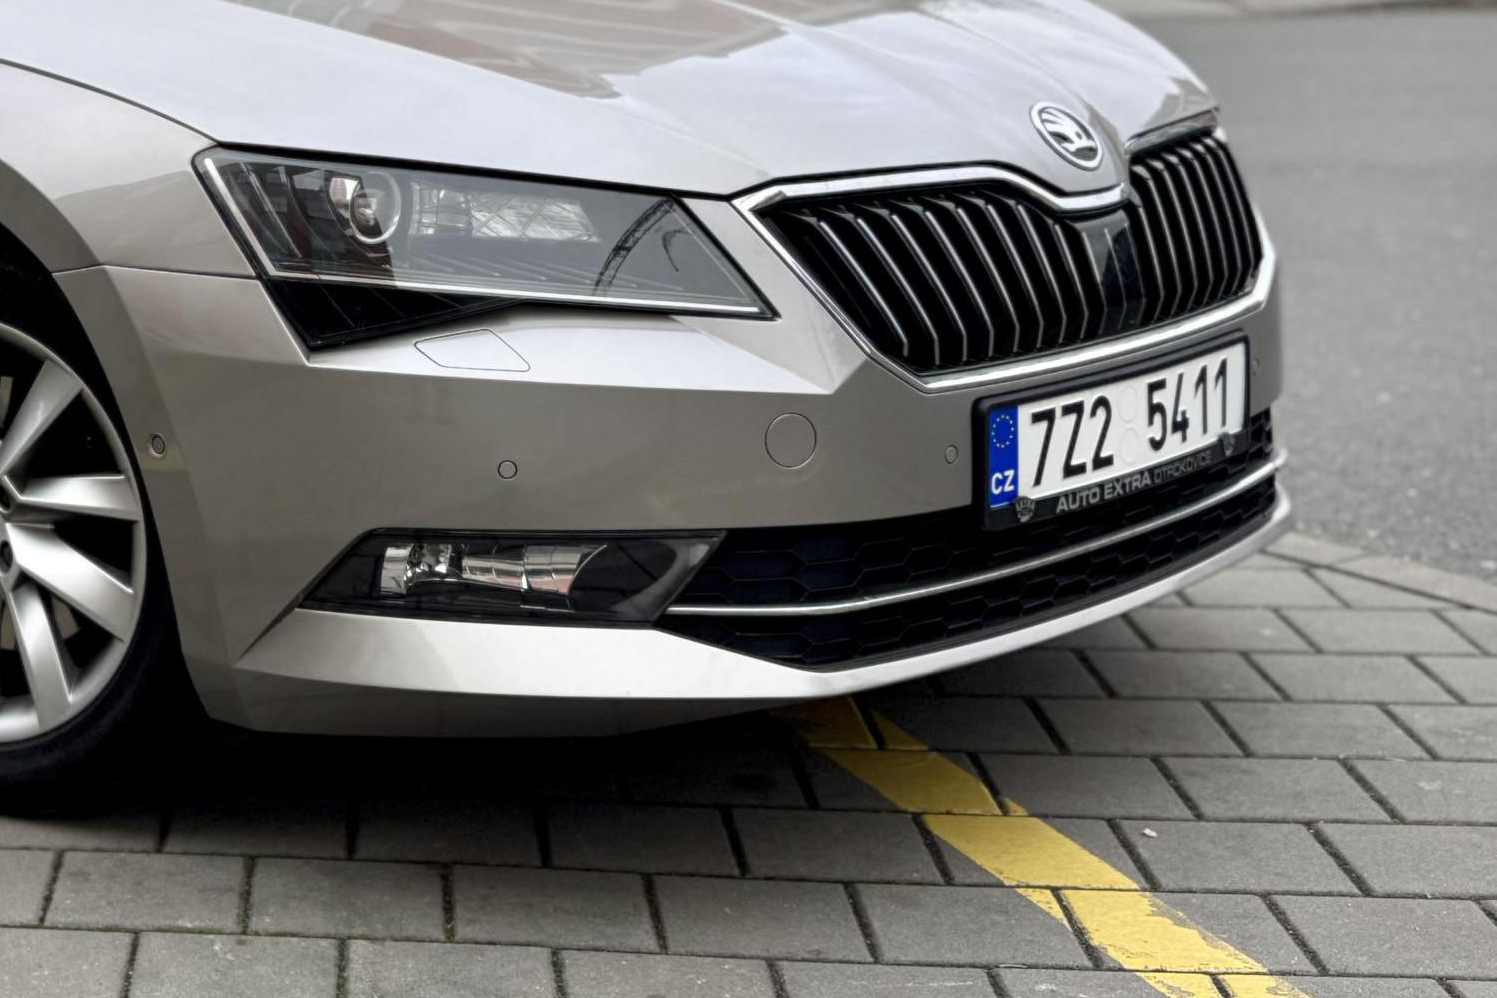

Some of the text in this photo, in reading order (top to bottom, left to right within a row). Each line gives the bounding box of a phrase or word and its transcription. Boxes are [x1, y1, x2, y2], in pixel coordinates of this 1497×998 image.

[1031, 357, 1228, 487] 7Z2 5411
[991, 469, 1015, 495] CZ
[1056, 487, 1100, 513] AUTO
[1103, 471, 1152, 498] EXTRA
[1154, 452, 1212, 483] OTROKOVICE
